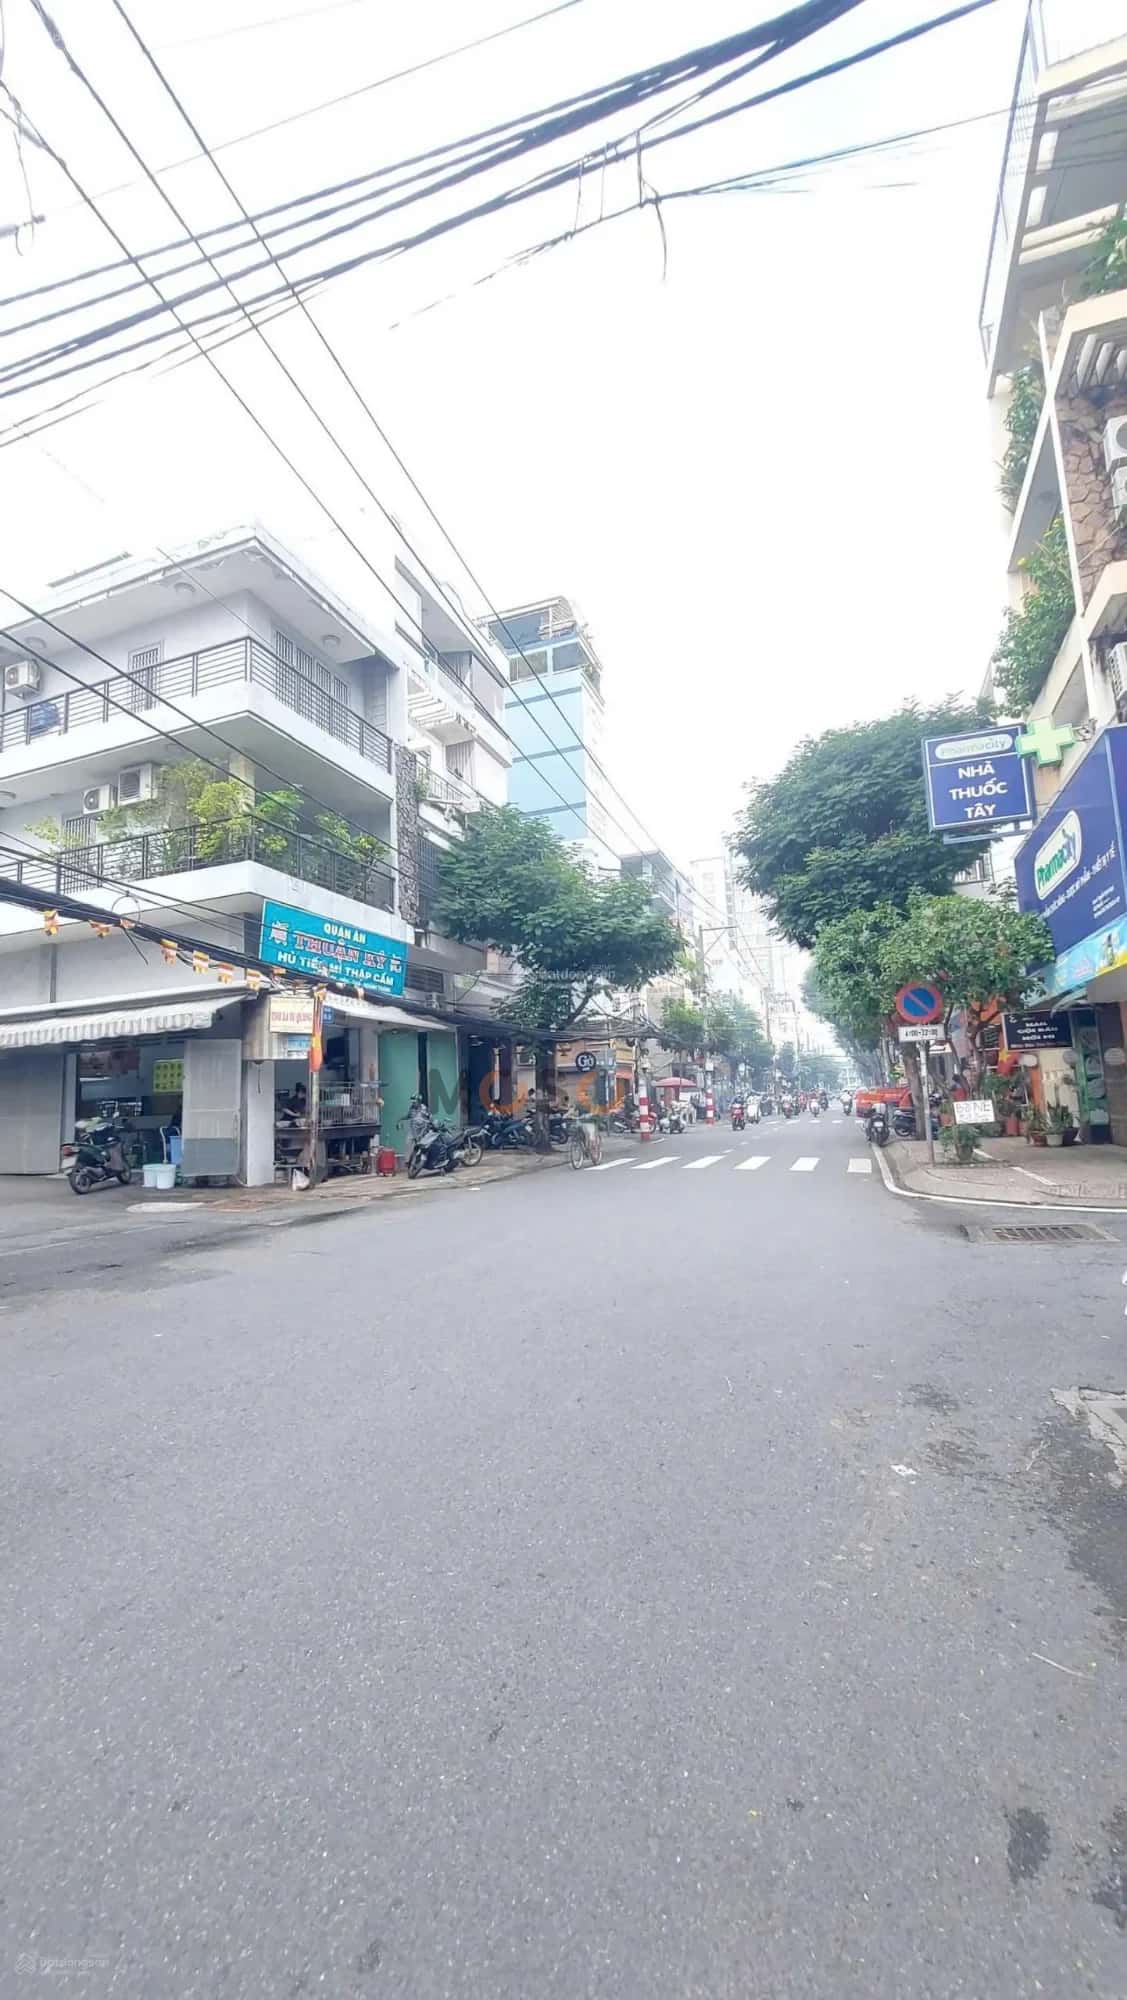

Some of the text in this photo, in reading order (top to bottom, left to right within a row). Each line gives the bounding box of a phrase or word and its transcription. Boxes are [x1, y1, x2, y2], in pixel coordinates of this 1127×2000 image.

[949, 777, 1008, 801] THUỐC
[964, 802, 996, 819] TÂY
[294, 930, 360, 963] THUẬN
